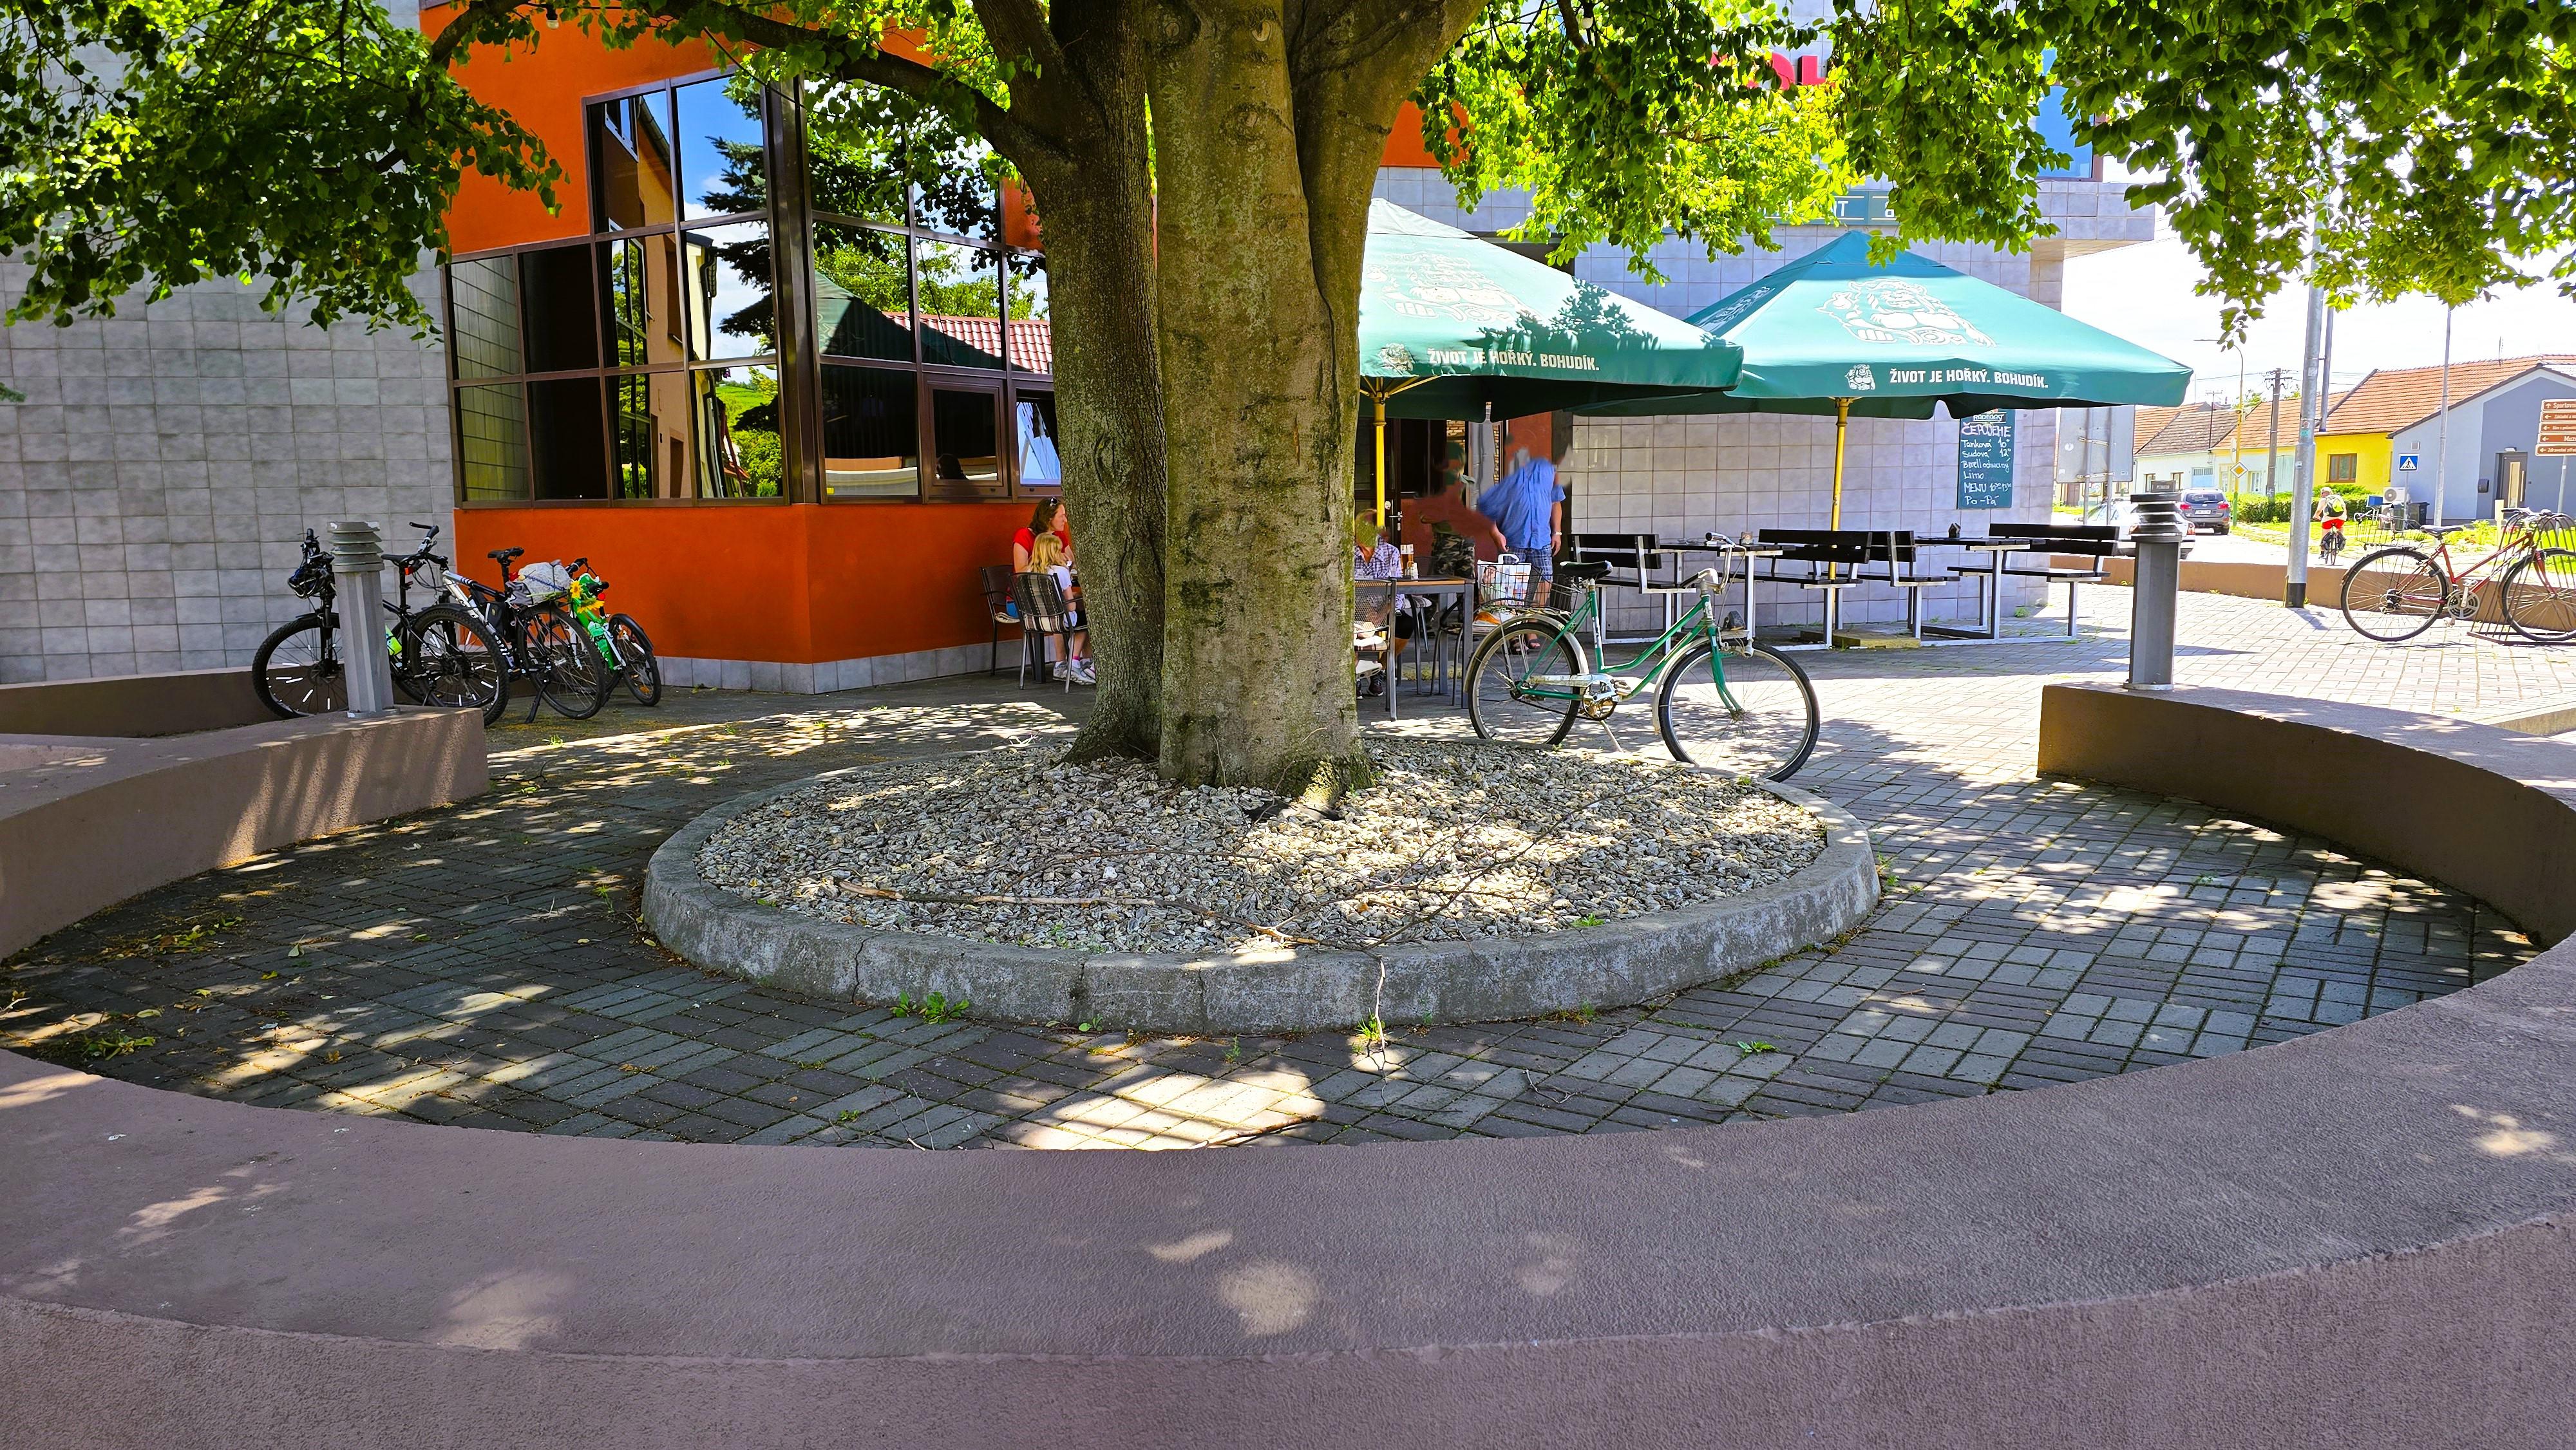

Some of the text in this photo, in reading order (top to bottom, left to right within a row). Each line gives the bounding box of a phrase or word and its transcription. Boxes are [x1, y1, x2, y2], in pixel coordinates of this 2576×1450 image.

[1427, 348, 1600, 371] ŽIVOT JE HOŘKÝ. BOHUDÍK.
[1889, 368, 2049, 388] ŽIVOT JE HOŘKÝ. BOHUDÍK.
[1960, 439, 1992, 447] Tanková
[1962, 449, 1991, 458] Sudová
[1963, 470, 1984, 479] Limo
[1964, 482, 1987, 493] MENU
